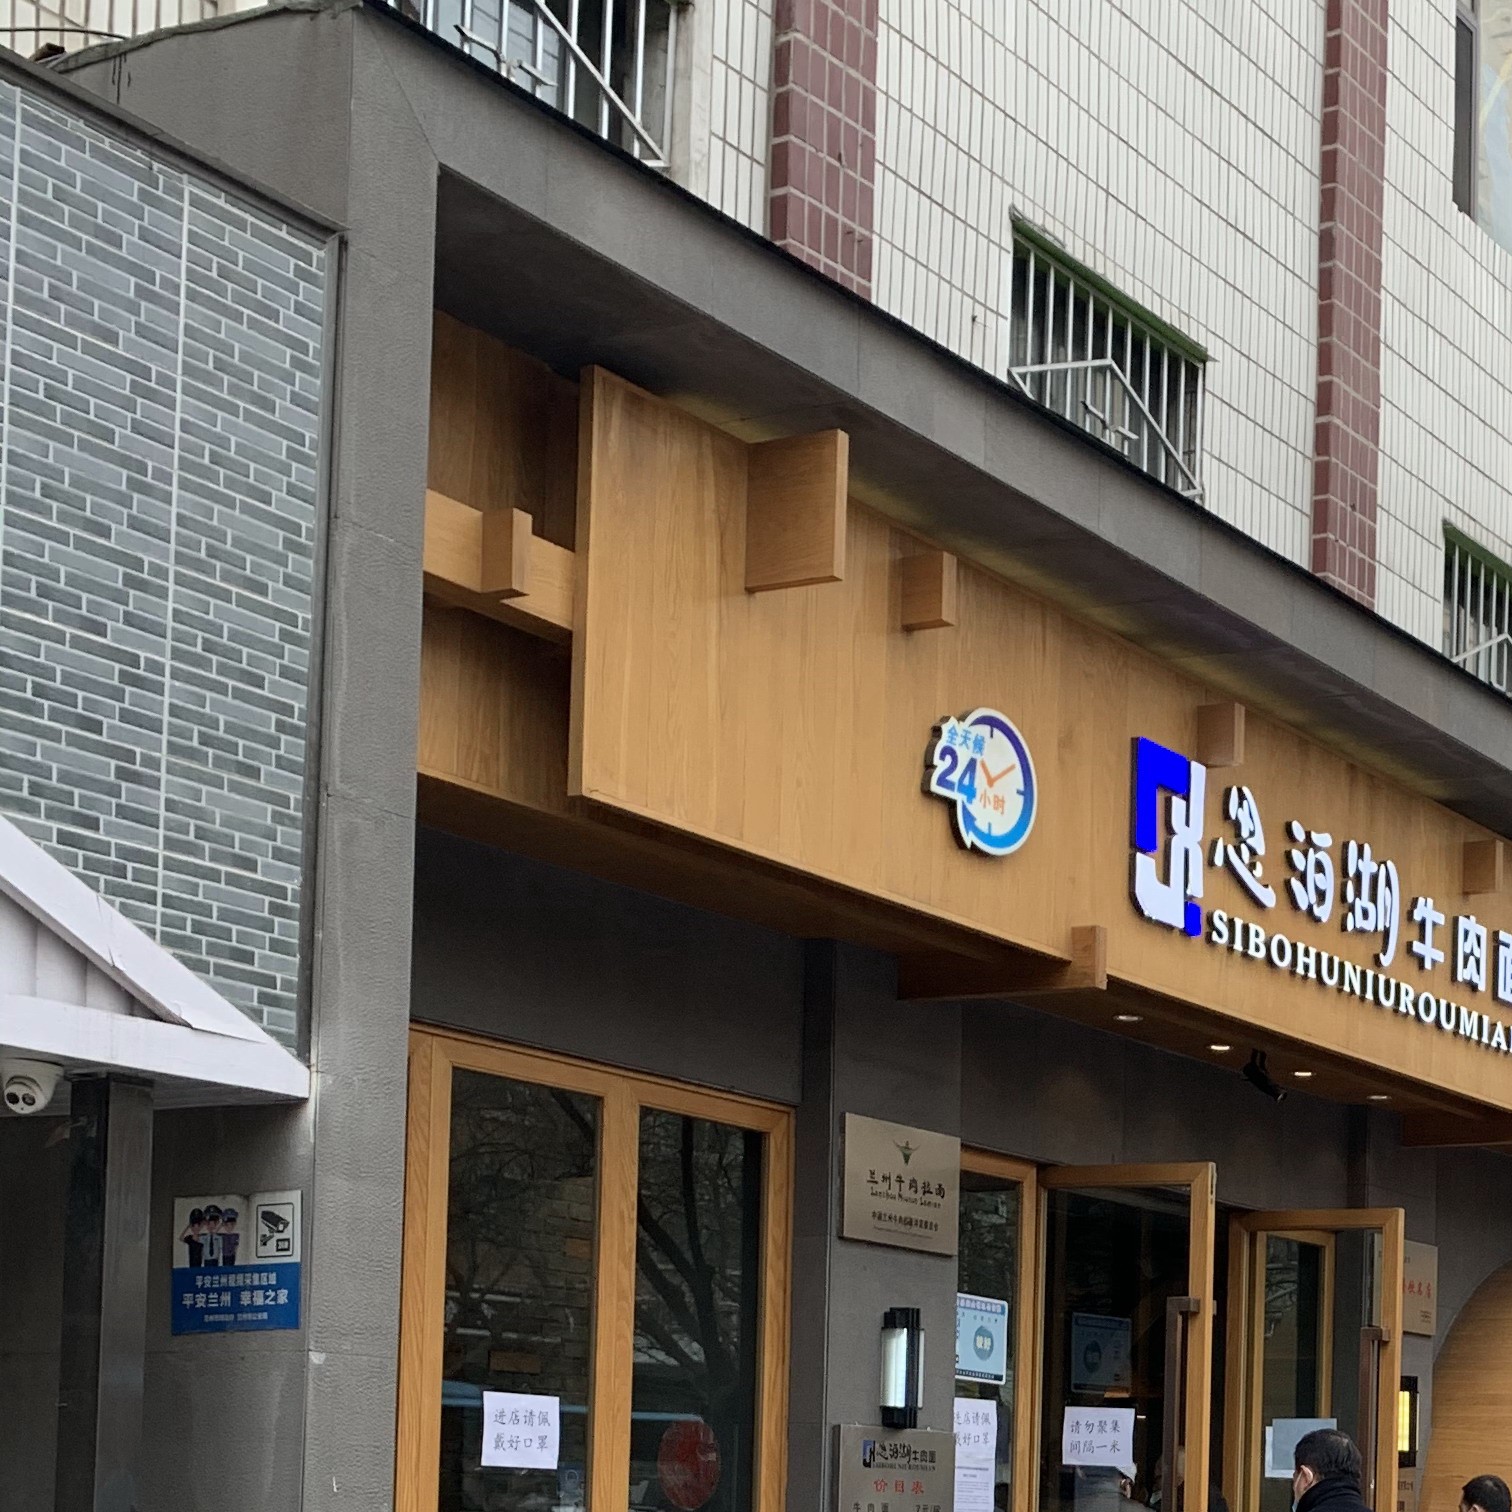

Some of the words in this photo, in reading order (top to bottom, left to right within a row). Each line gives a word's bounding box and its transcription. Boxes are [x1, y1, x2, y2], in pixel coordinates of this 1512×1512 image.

[947, 725, 985, 757] 全天候
[936, 745, 977, 804] 24
[980, 790, 1005, 815] 小时
[182, 1292, 231, 1309] 平安兰州
[240, 1289, 288, 1306] 幸福之家
[493, 1408, 550, 1427] 进店请佩
[1071, 1420, 1120, 1434] 请勿聚集
[493, 1433, 548, 1452] 戴好口罩
[1070, 1440, 1120, 1455] 间隔一米
[874, 1479, 924, 1494] 价目表
